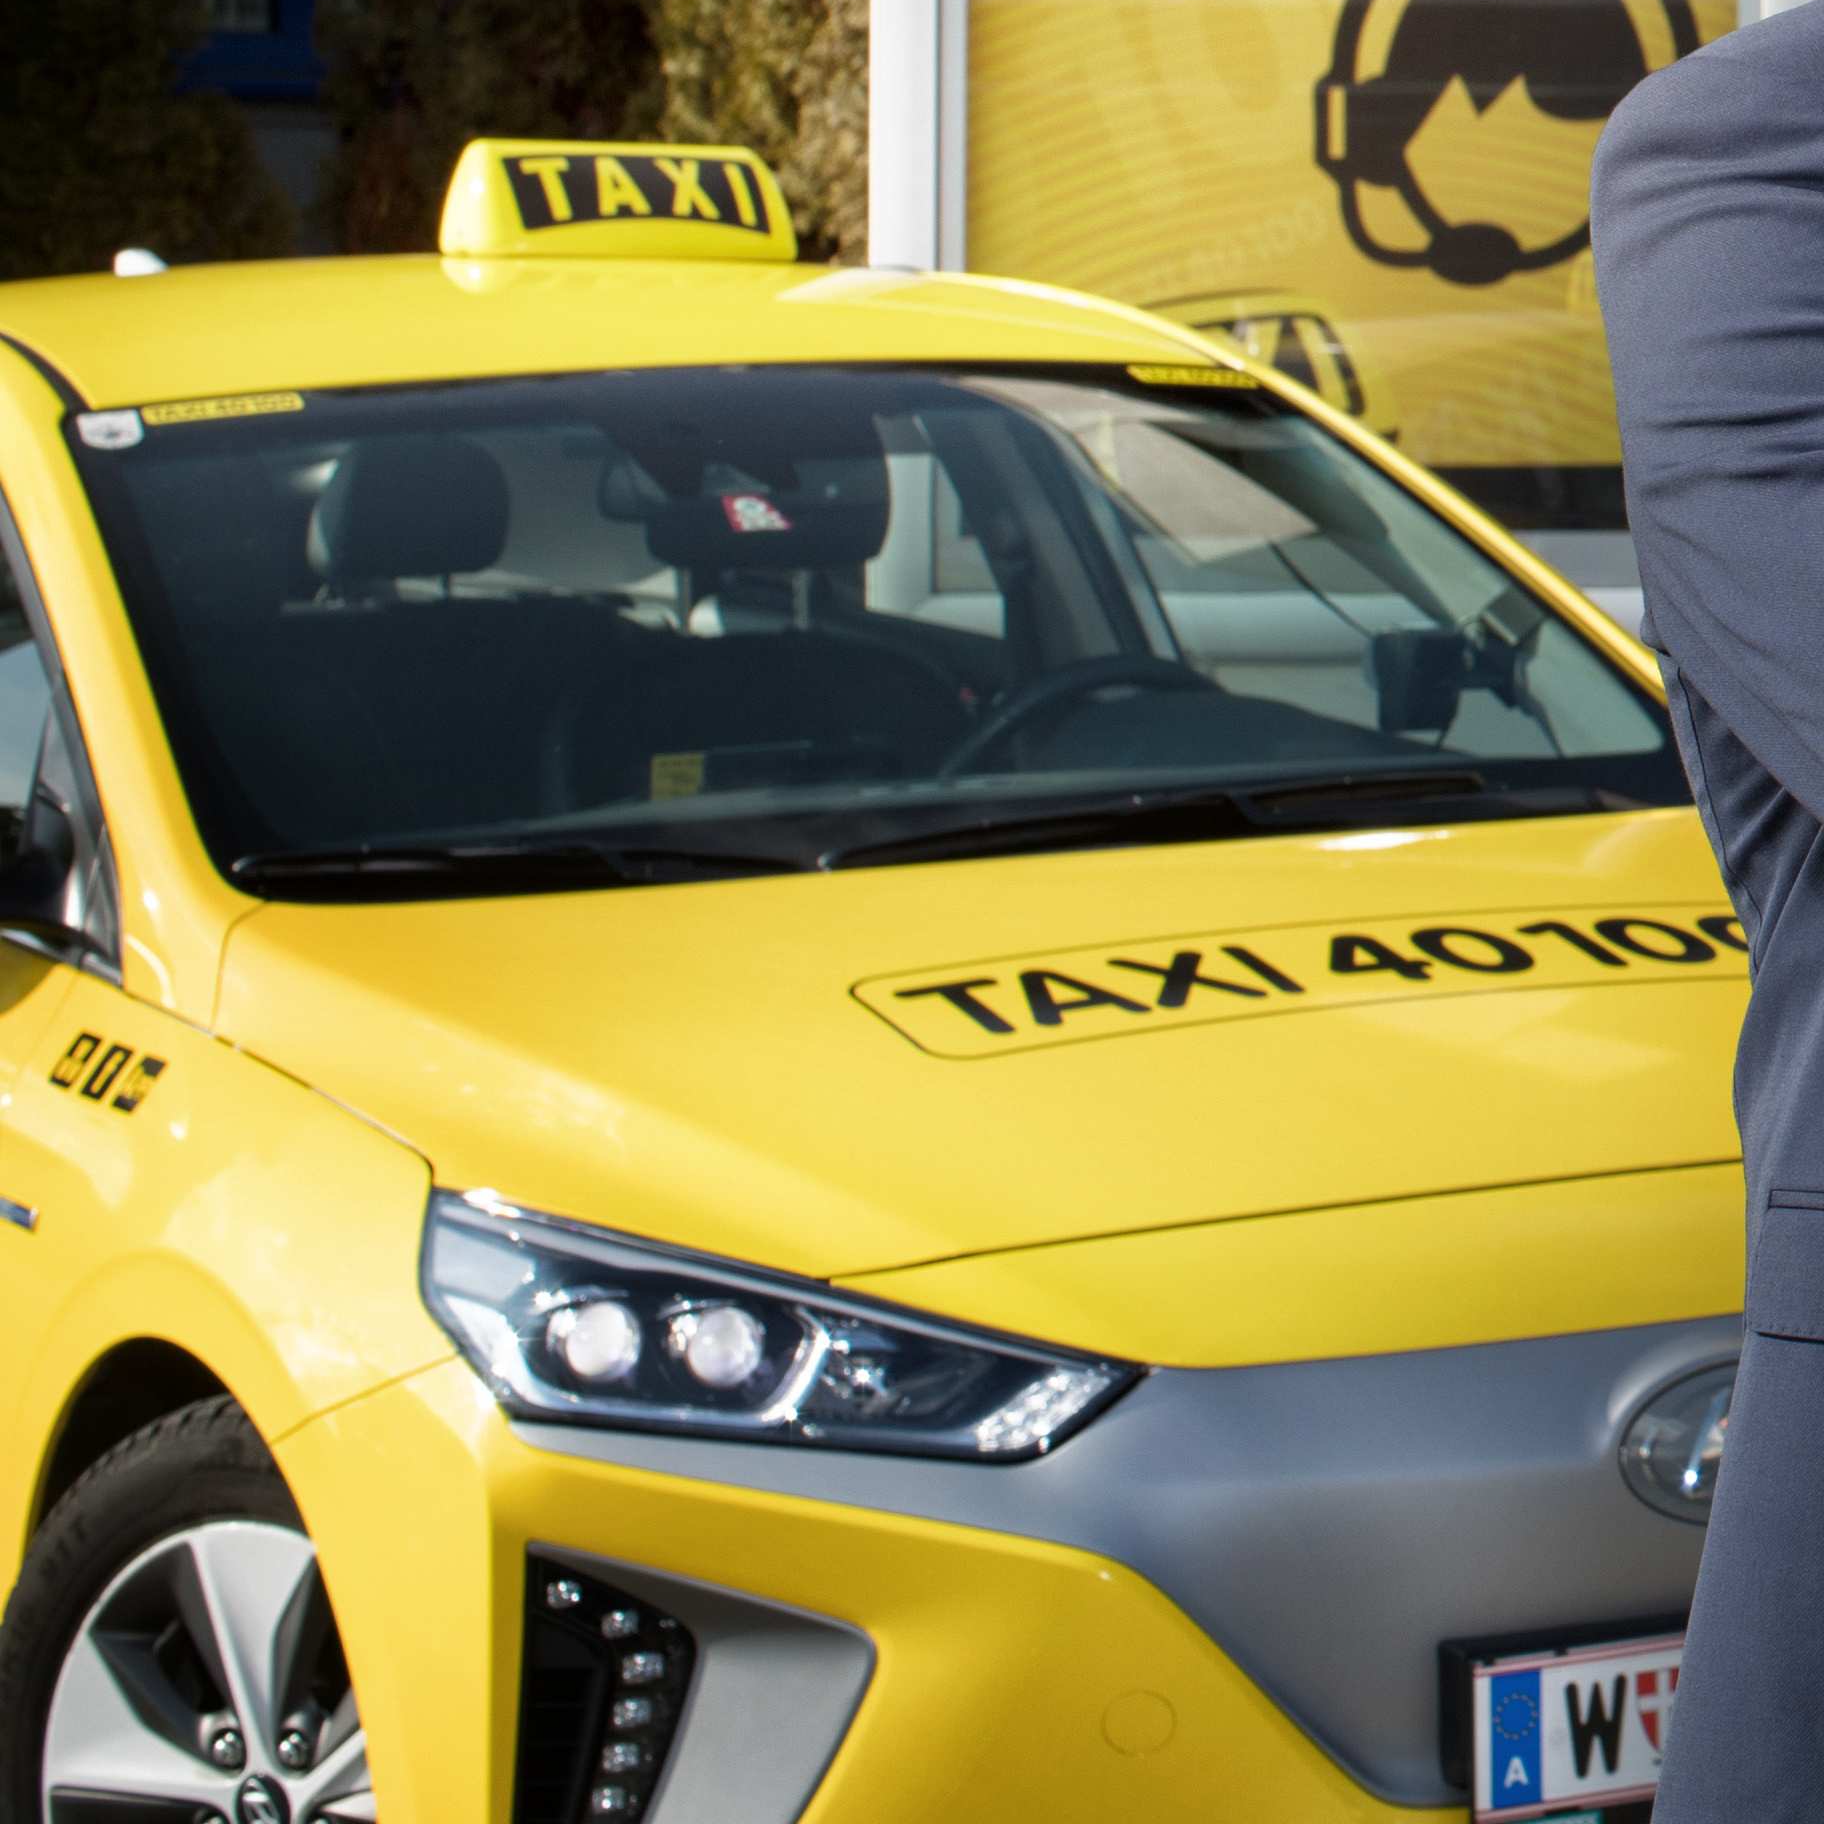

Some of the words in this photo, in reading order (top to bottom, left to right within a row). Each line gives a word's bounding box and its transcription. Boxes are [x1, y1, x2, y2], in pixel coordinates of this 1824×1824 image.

[518, 154, 759, 228] TAXI
[893, 942, 1306, 1036] TAXI
[1564, 1672, 1628, 1780] W
[1503, 1755, 1529, 1790] A
